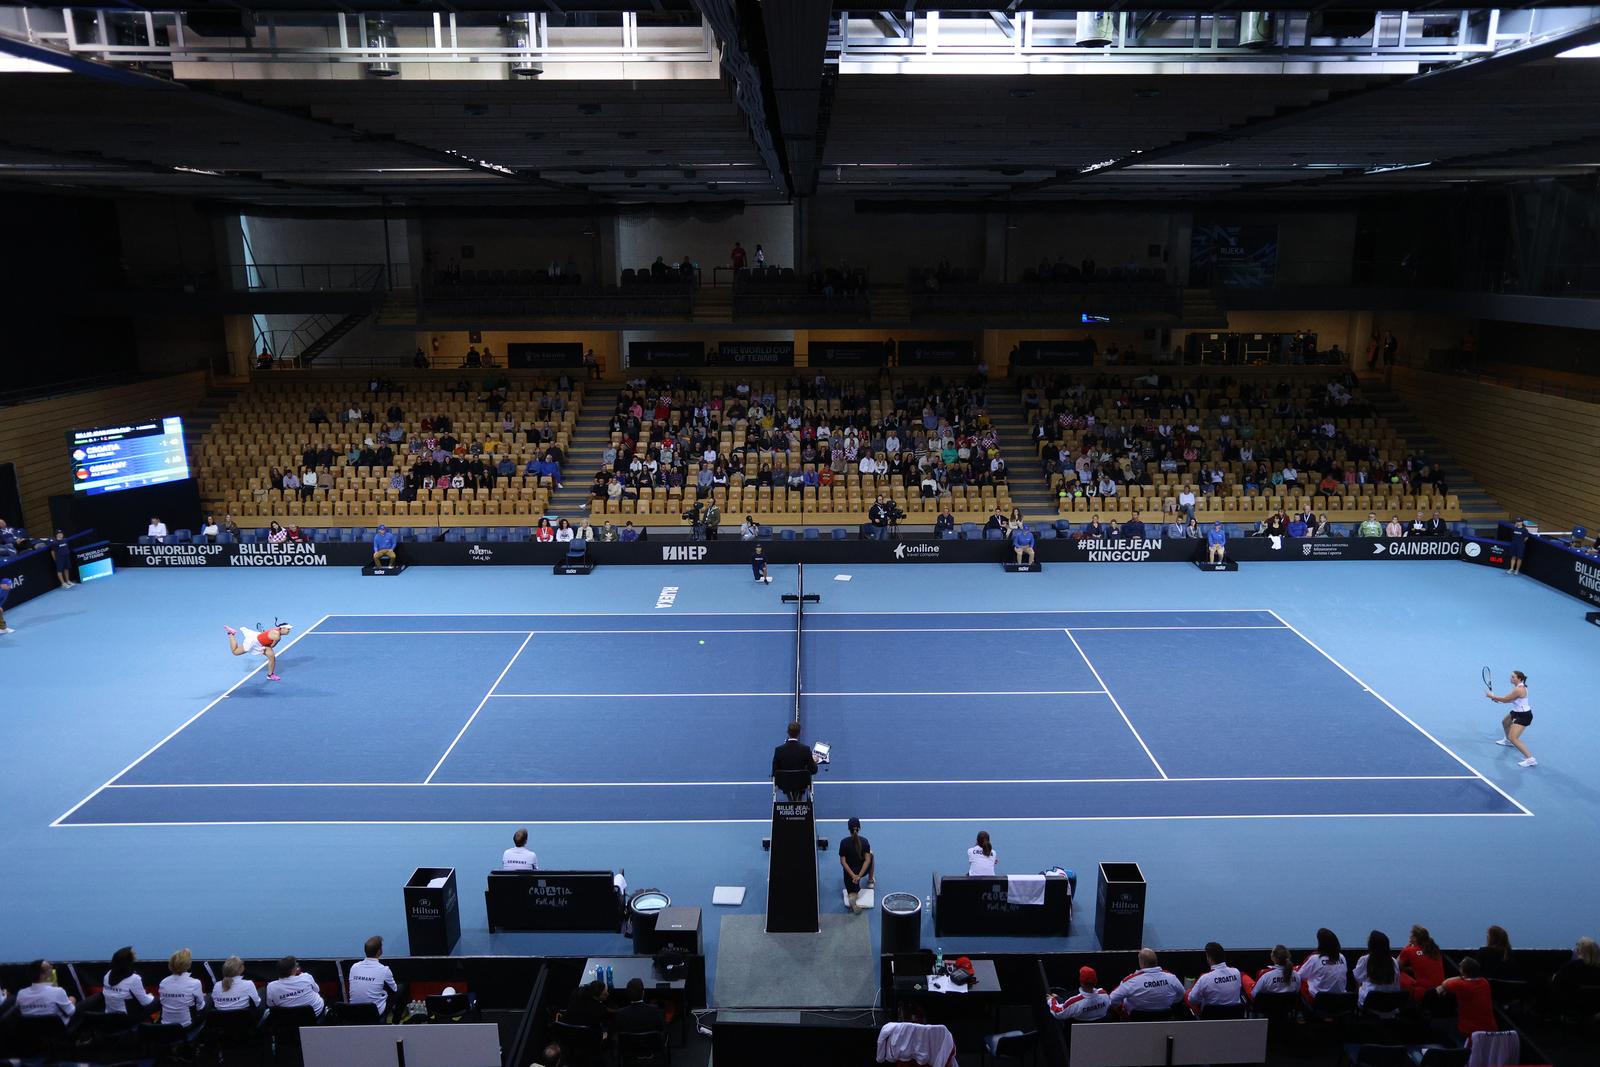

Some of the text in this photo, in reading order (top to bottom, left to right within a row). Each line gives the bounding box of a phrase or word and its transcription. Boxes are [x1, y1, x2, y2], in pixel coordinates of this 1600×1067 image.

[721, 343, 791, 353] THE WORLD CUP
[735, 354, 778, 362] OF TENNIS
[239, 543, 316, 554] BILLIEJEAN
[906, 543, 940, 553] uniline
[1077, 539, 1161, 550] #BILLIEJEAN
[1389, 542, 1462, 555] GAINBRIDG
[86, 549, 100, 557] WORLD
[127, 545, 223, 555] THE WORLD CUP
[678, 546, 707, 560] HEP
[146, 556, 207, 565] OF TENNIS
[230, 555, 327, 566] KINGCUP.COM
[1088, 551, 1150, 561] KINGCUP
[1111, 900, 1139, 909] Hilton
[411, 906, 439, 915] Hilton
[1144, 979, 1169, 988] CROATIA
[1214, 974, 1237, 984] CROATIA
[280, 989, 305, 1000] GERMANY
[1082, 1002, 1106, 1013] CROATIA
